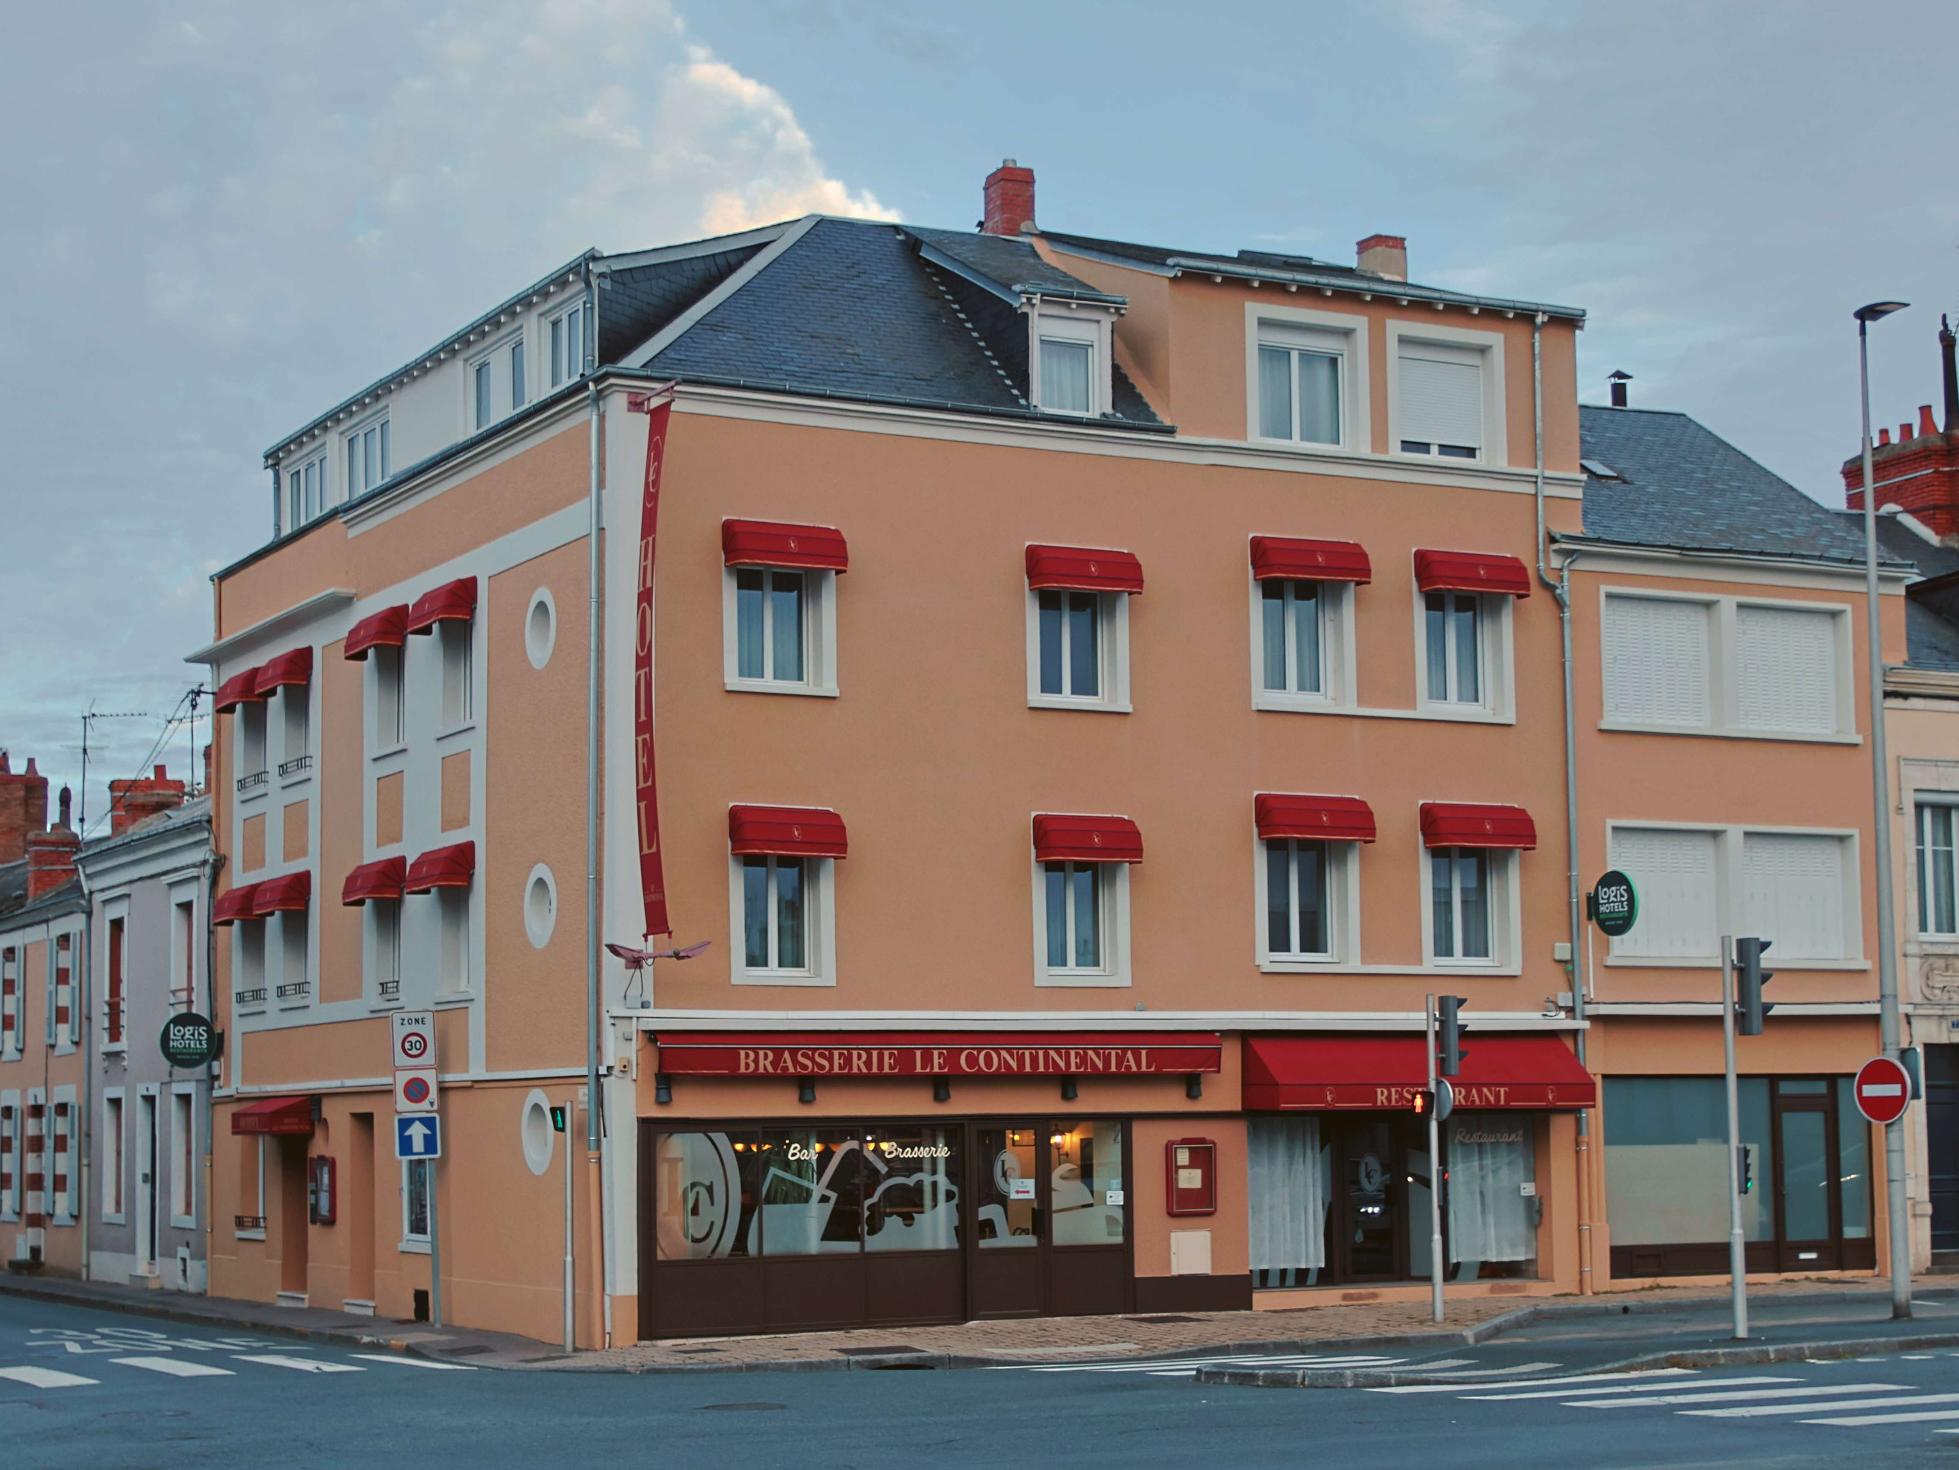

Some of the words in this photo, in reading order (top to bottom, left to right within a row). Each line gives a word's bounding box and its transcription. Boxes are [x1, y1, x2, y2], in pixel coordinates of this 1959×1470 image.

[635, 534, 656, 856] HOTEL
[1598, 885, 1628, 903] Logis
[1599, 901, 1628, 913] HOTELS
[400, 1016, 427, 1026] ZONE
[170, 1023, 208, 1040] Logis
[170, 1040, 208, 1049] HOTELS
[406, 1040, 423, 1052] 30
[737, 1049, 899, 1073] BRASSERIE
[914, 1049, 949, 1073] LE
[959, 1049, 1156, 1073] CONTINENTAL
[1376, 1087, 1510, 1106] RESRANT
[1455, 1128, 1525, 1144] Restaurant
[788, 1143, 819, 1161] Bar
[884, 1141, 951, 1159] Brasserie
